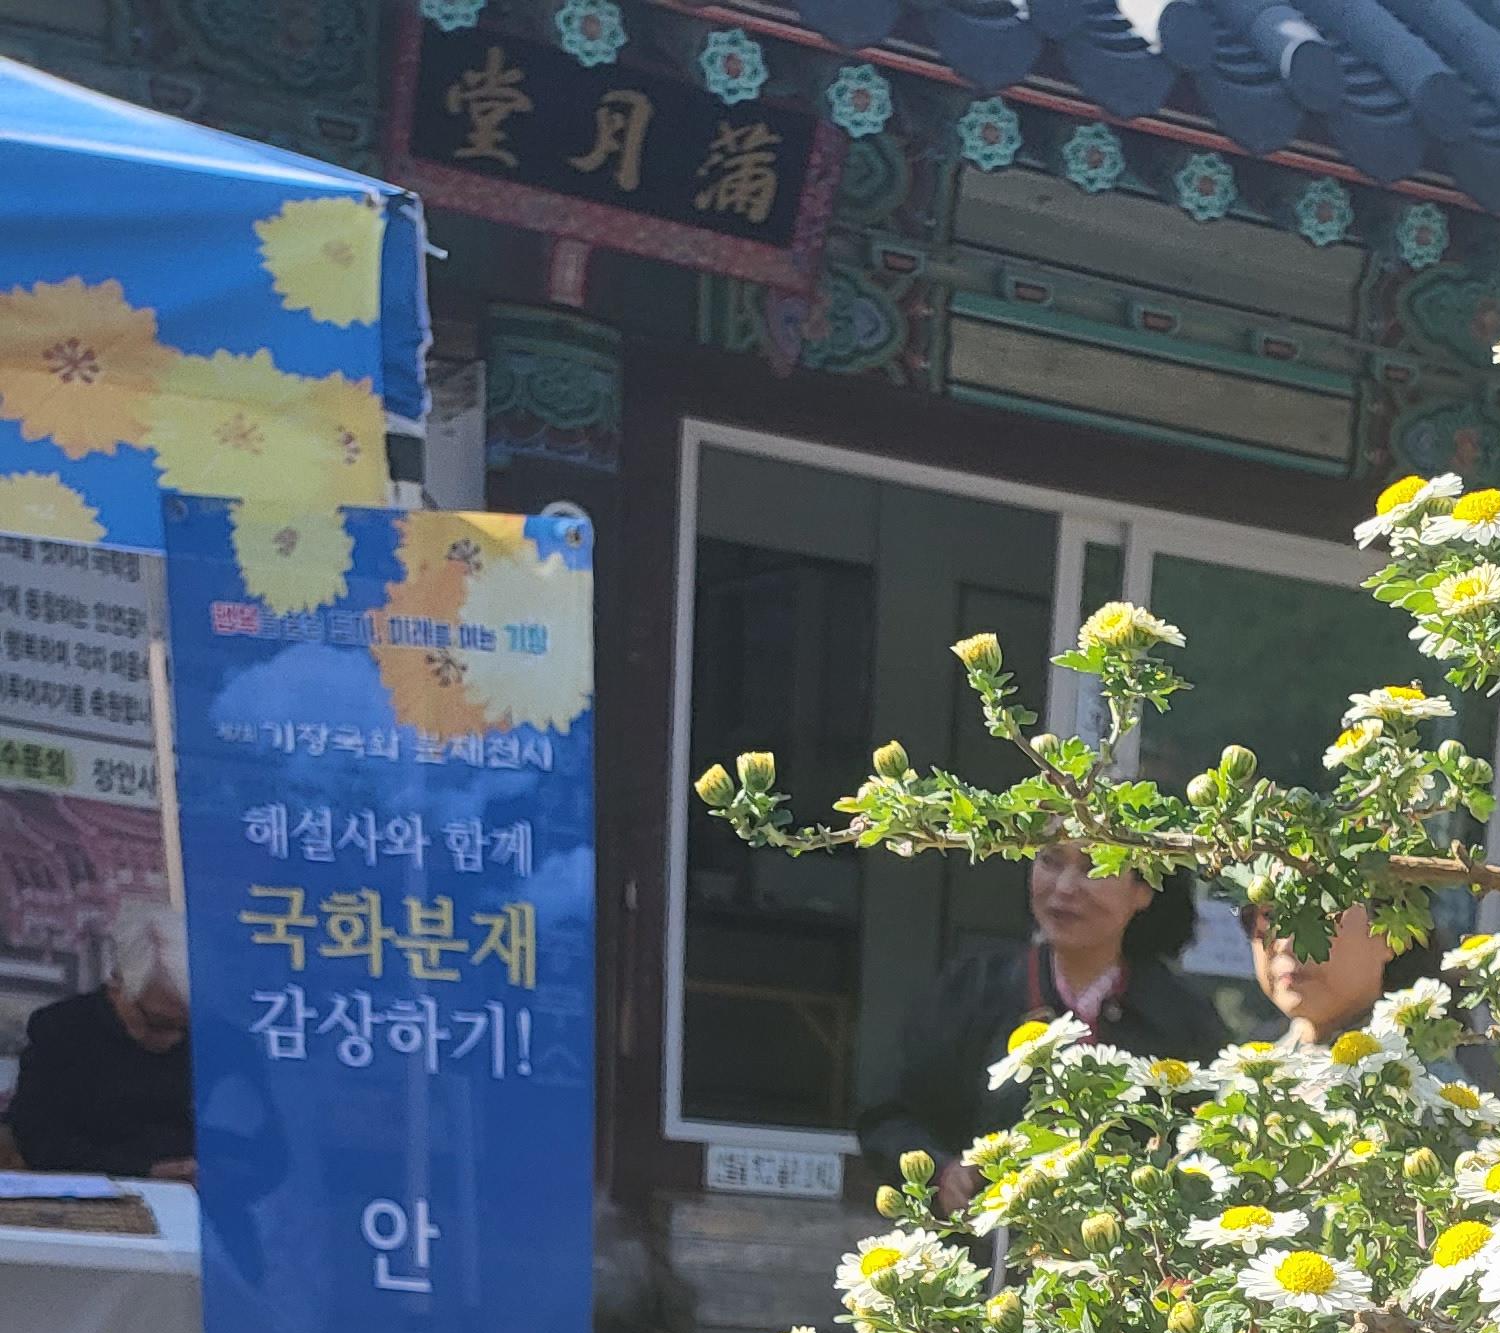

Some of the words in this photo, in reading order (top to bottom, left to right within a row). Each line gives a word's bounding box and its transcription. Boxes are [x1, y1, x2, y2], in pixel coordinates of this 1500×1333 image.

[243, 804, 430, 869] 해설사와
[442, 821, 533, 877] 함께
[239, 884, 536, 990] 국화분재
[251, 984, 533, 1079] 감상하기!
